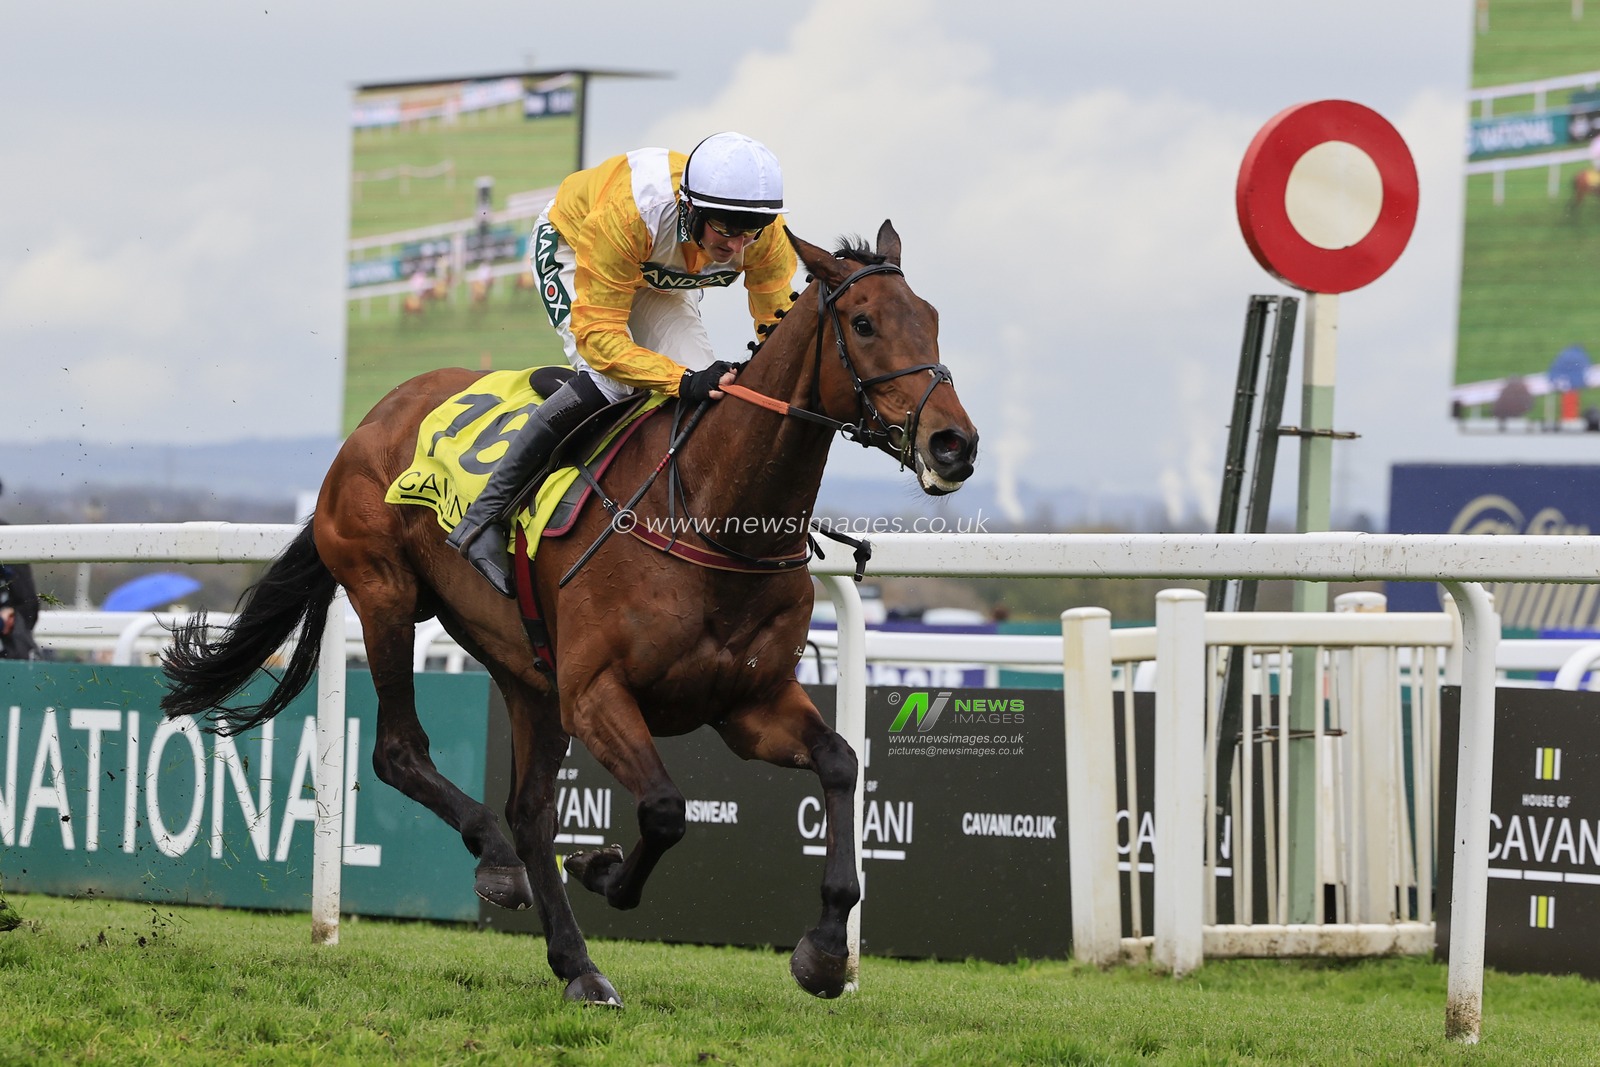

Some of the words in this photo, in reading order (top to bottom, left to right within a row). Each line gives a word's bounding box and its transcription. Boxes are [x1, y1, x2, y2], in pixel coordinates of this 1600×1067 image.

[427, 393, 540, 475] 16
[685, 800, 738, 824] NSWEAR
[1522, 794, 1555, 807] HOUSE
[1557, 795, 1571, 808] OF
[797, 796, 914, 844] CANI
[962, 812, 1057, 839] CAVANI.CO.UK
